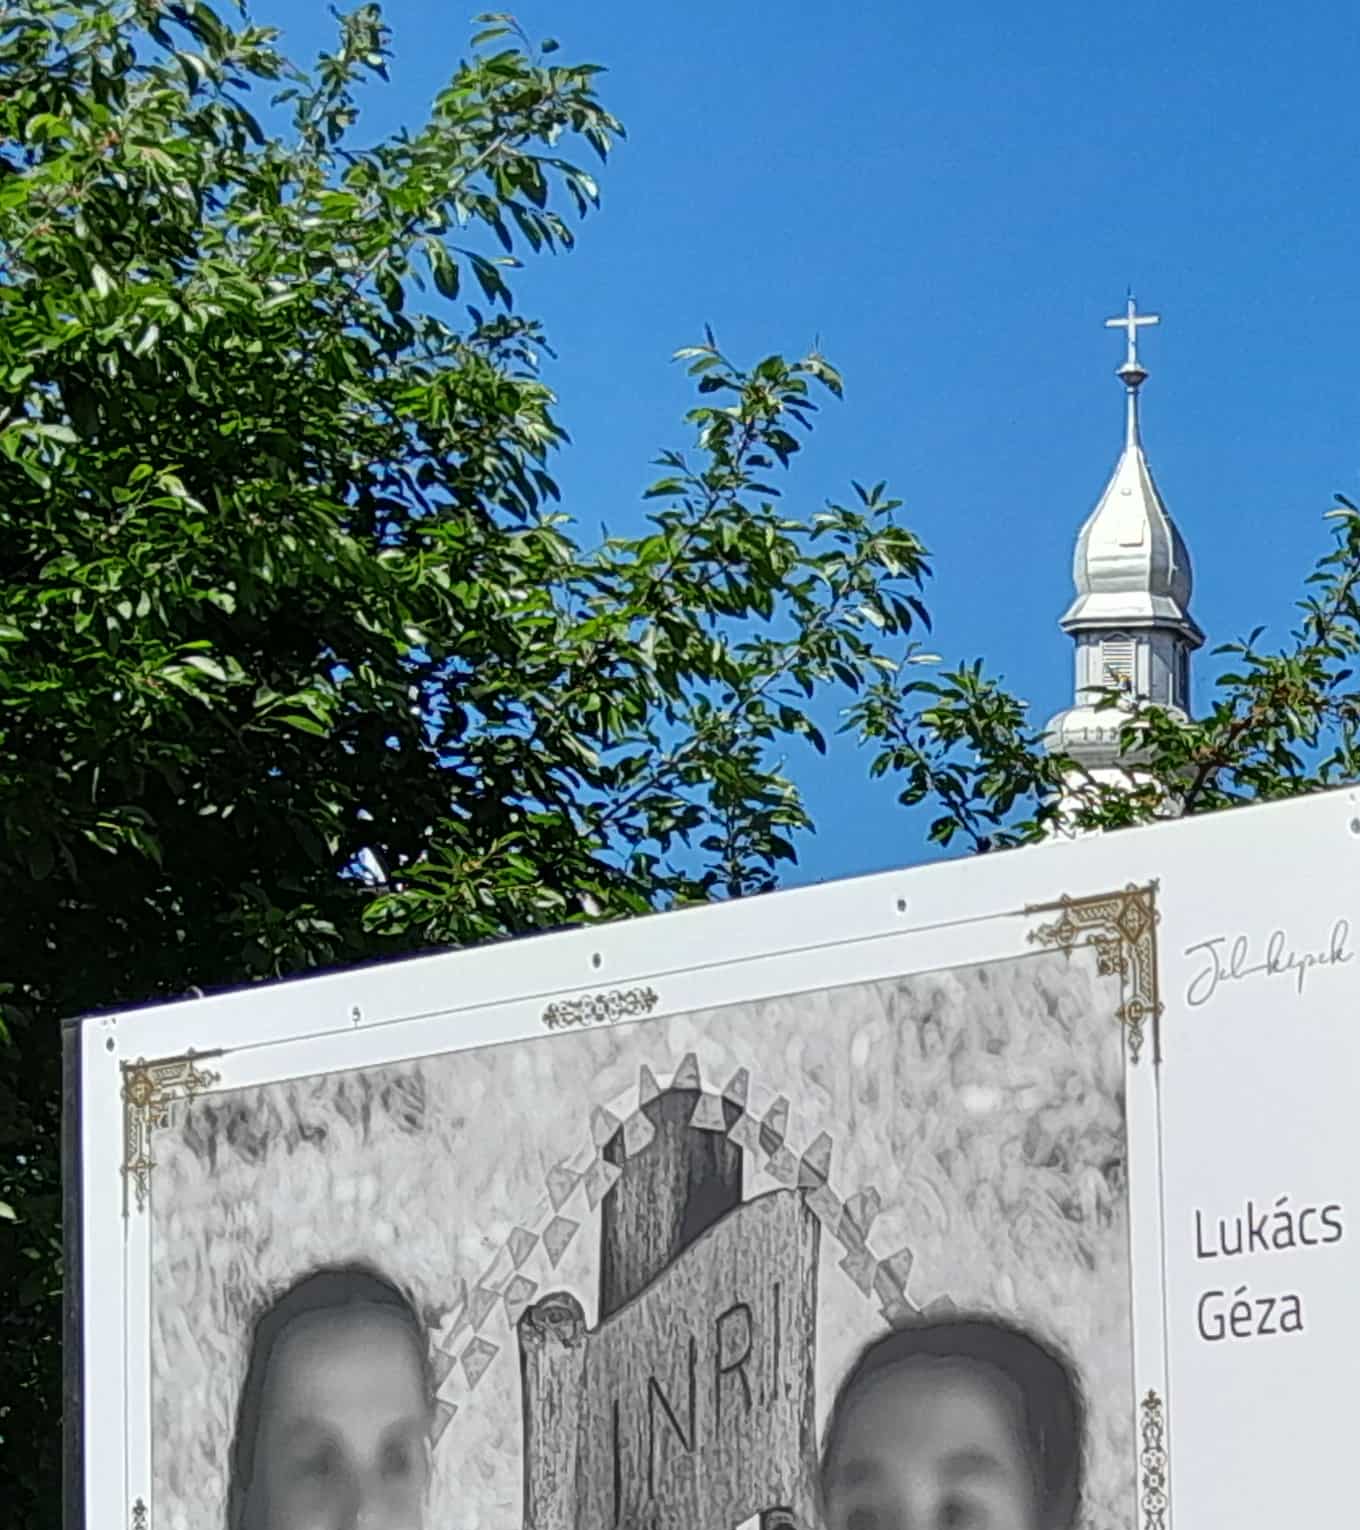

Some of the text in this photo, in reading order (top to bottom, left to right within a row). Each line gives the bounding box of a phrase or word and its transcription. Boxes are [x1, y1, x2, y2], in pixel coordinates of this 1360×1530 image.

[1195, 1196, 1343, 1258] Lukács
[1198, 1286, 1304, 1341] Géza
[612, 1281, 784, 1528] INRI
